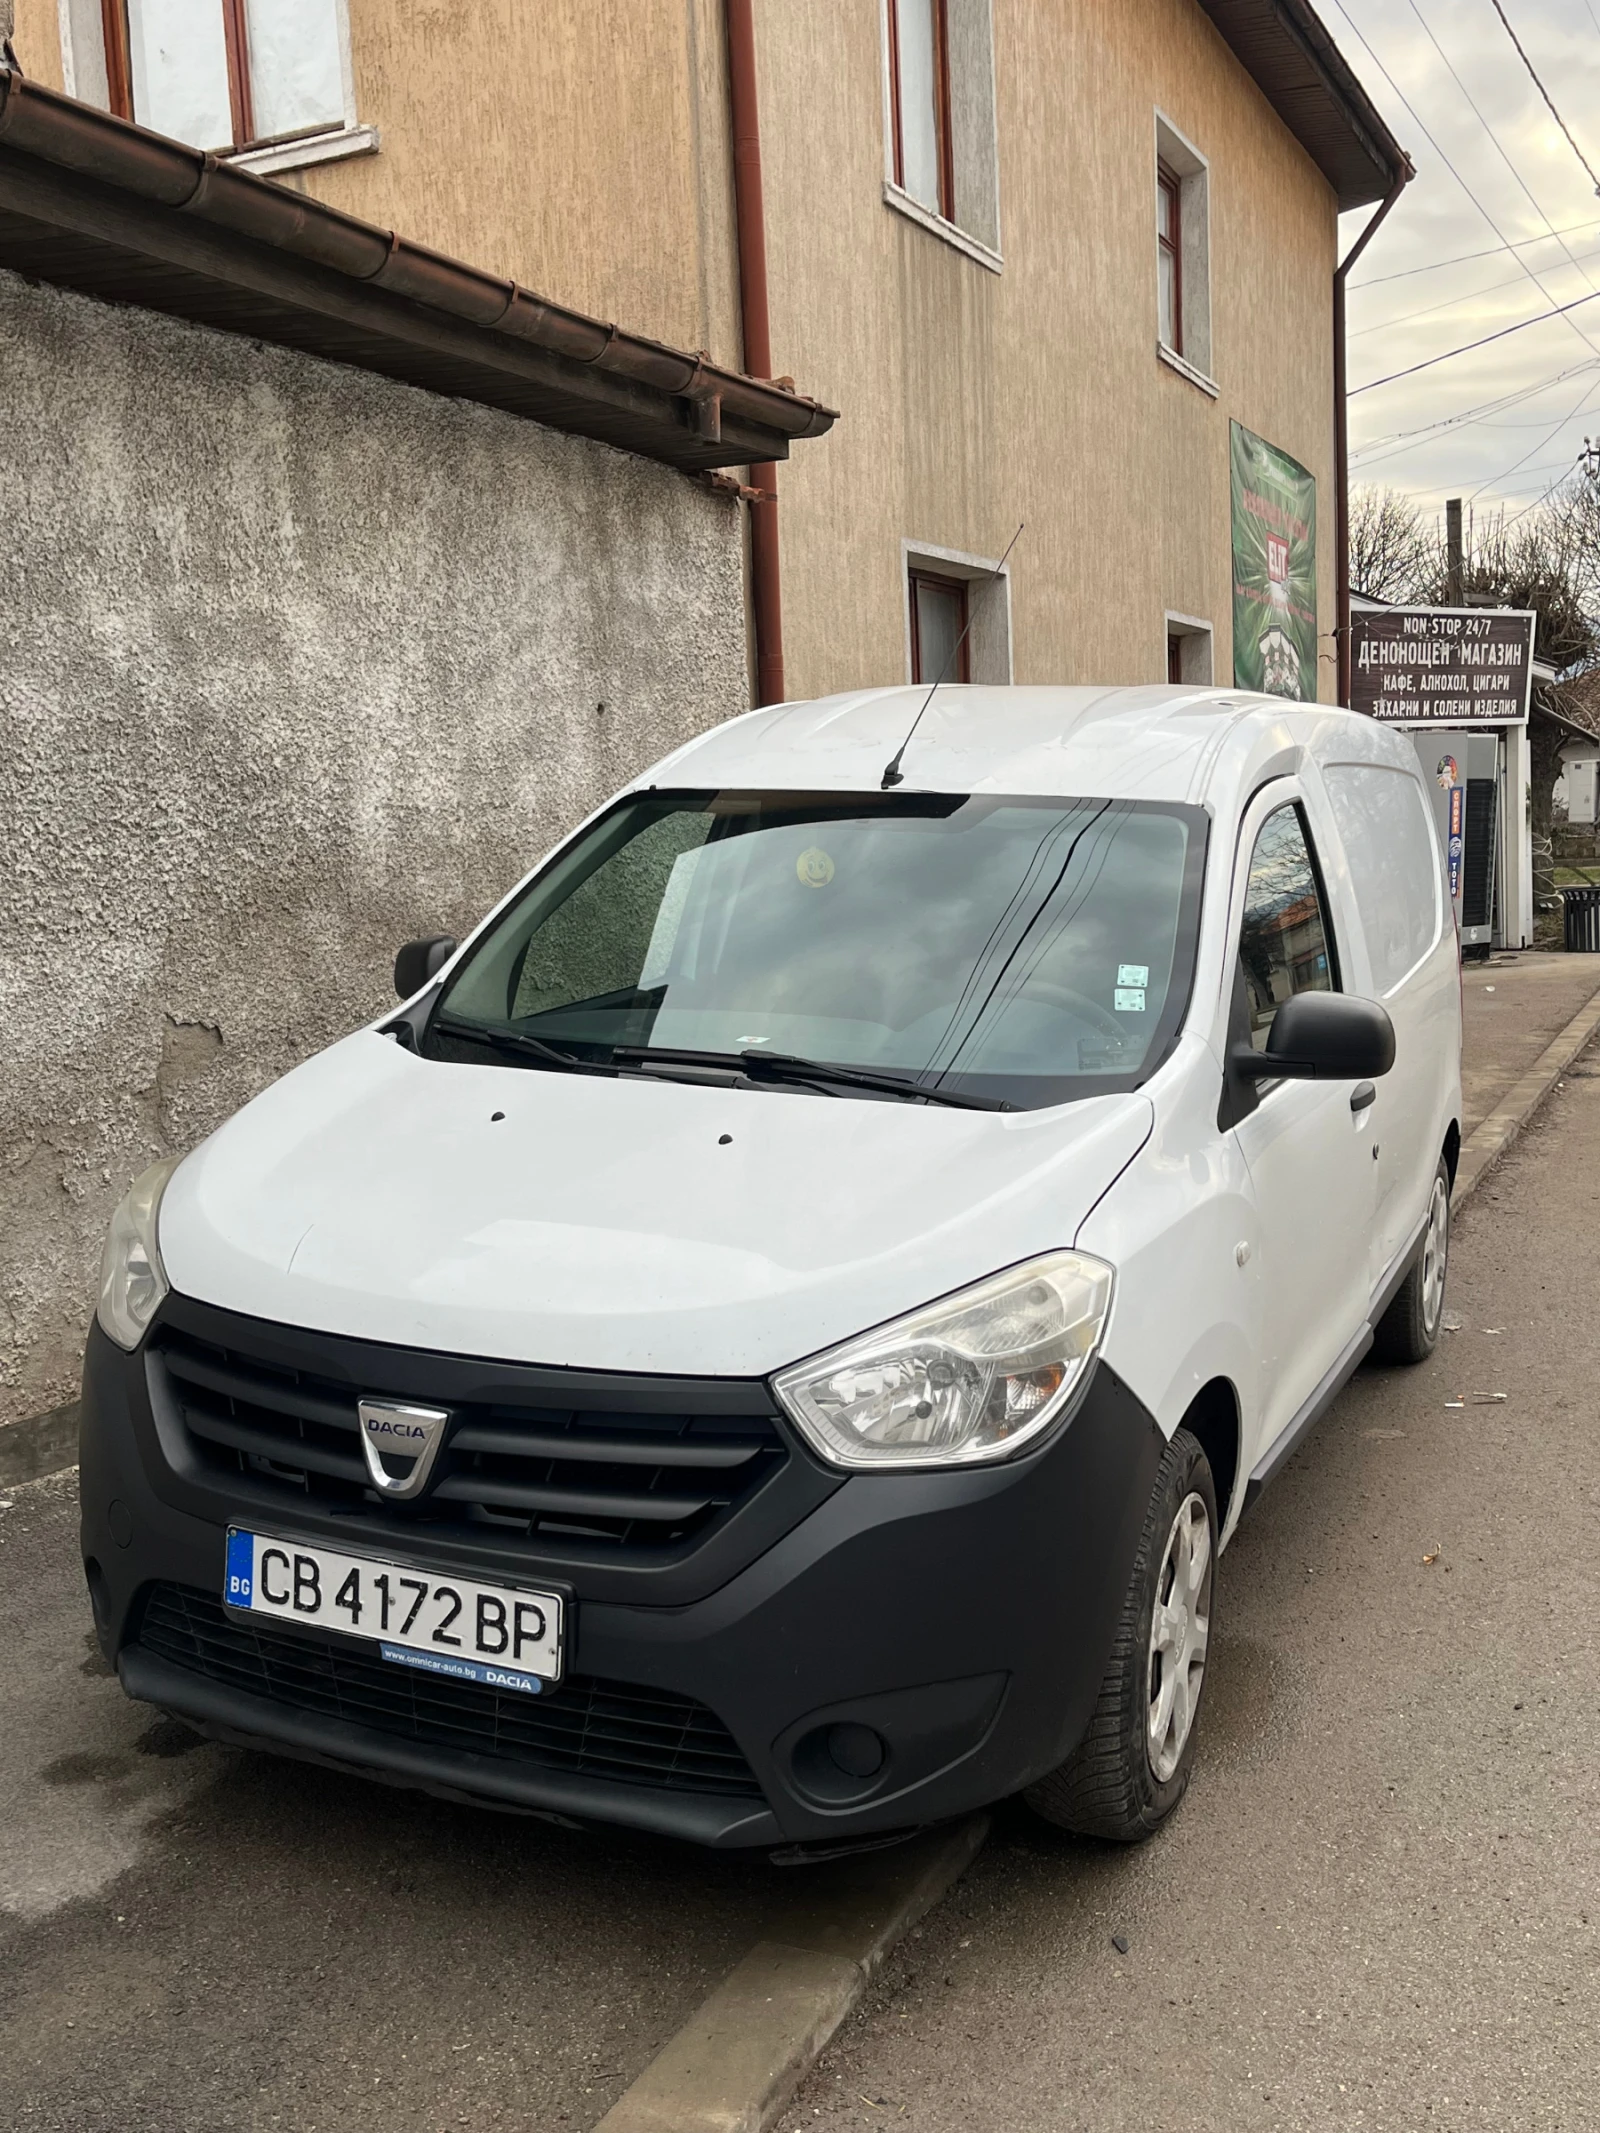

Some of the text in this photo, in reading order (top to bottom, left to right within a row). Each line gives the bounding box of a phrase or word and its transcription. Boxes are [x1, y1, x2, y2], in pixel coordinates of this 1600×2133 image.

[1465, 618, 1492, 638] 24/7
[1358, 640, 1522, 669] ДЕНОНОЩЕН МАГАЗИН
[1383, 674, 1510, 693] КАФЕ, АЛКОХОЛ, ЦИГАРИ
[1372, 699, 1517, 718] ЗАХАРНИ И СОЛЕНИ ИЗДЕЛИЯ
[367, 1418, 426, 1440] DACIA
[230, 1548, 547, 1660] BG CB 4172 BP
[384, 1650, 532, 1691] www.omnicar-auto.bg DACIA
